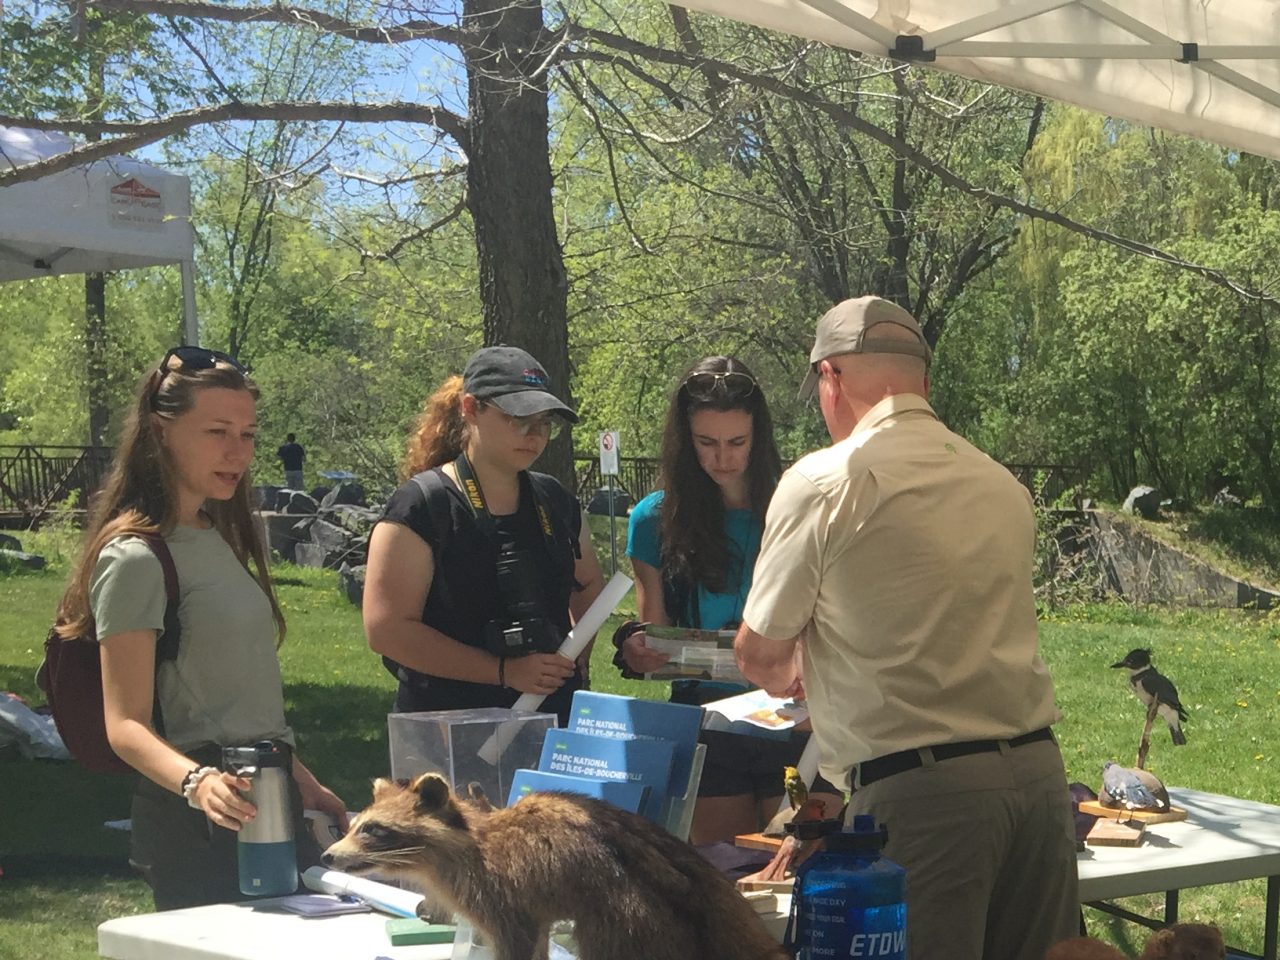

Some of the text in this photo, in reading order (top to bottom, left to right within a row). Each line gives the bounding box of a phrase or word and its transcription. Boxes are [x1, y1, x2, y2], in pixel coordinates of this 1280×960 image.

[465, 480, 484, 509] Nikon
[577, 718, 627, 731] PARC NATIONAL
[550, 762, 565, 771] DES
[552, 753, 608, 769] PARC NATIONAL
